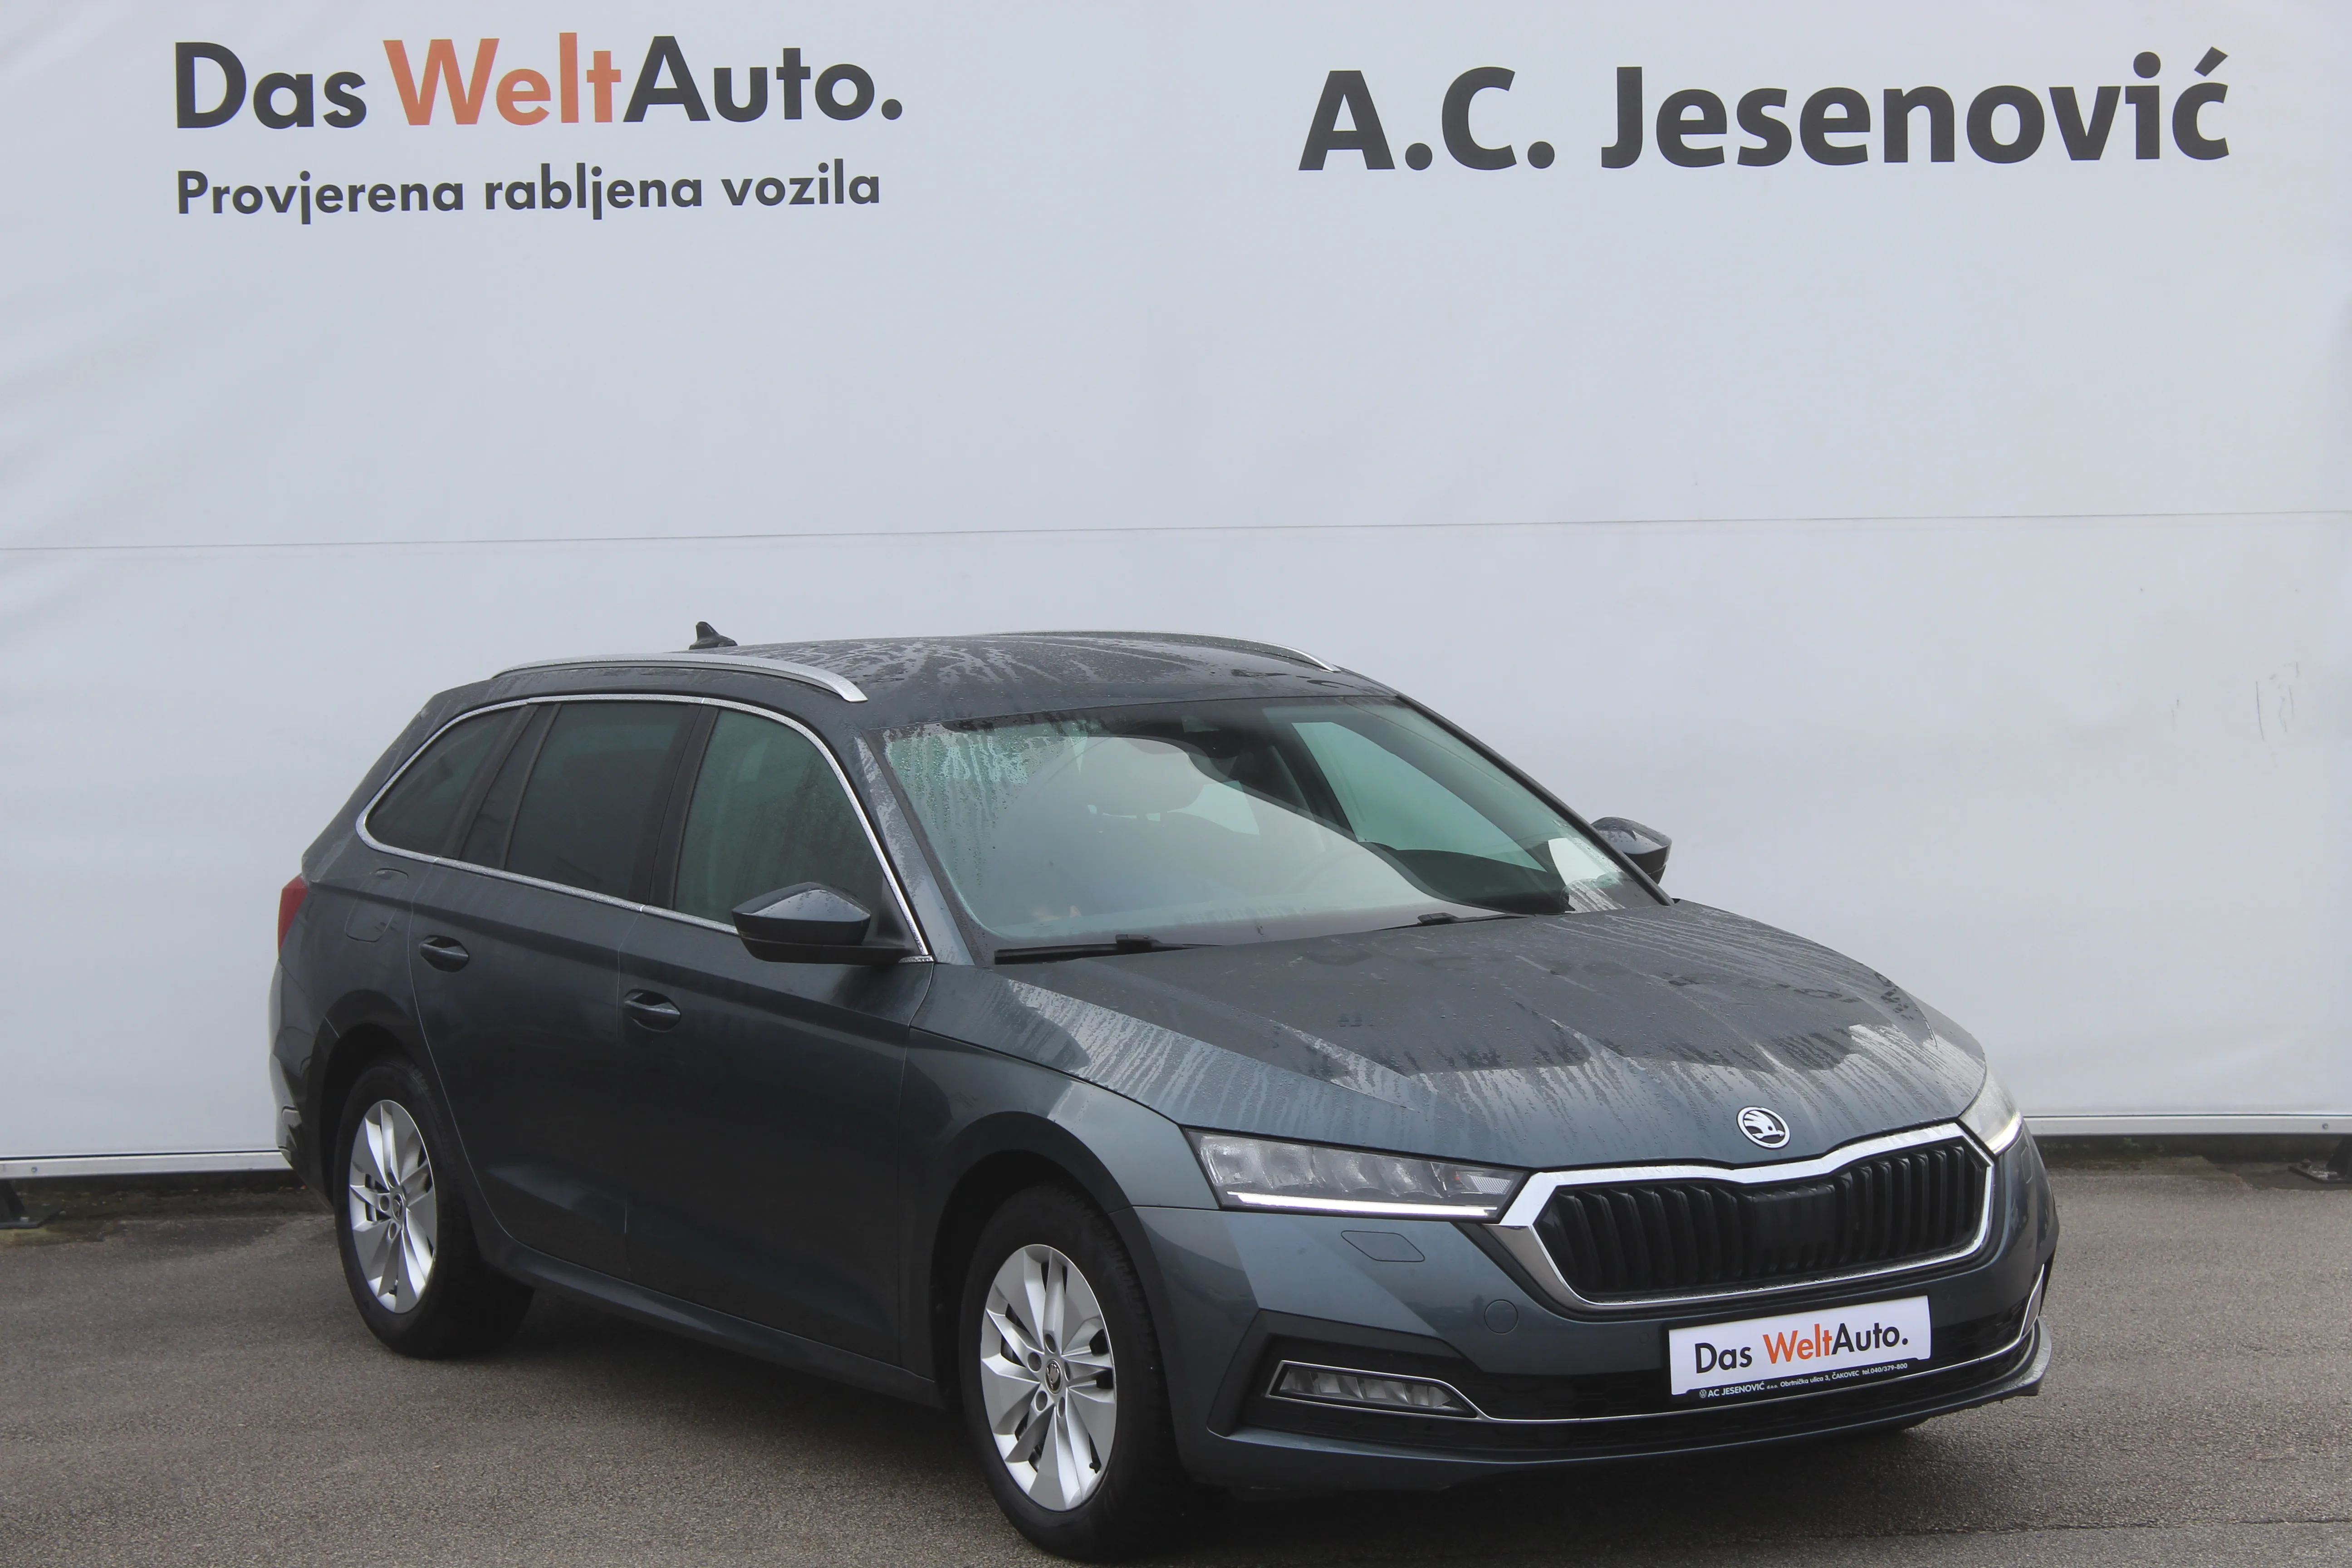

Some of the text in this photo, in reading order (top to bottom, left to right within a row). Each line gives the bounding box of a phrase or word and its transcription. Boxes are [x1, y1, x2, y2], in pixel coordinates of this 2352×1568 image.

[176, 33, 902, 129] Das WeltAuto.
[1298, 47, 2229, 171] A.C. Jesenović
[178, 159, 879, 225] Provjerena rabljena vozila
[1695, 1323, 1908, 1373] Das WeltAuto.
[1708, 1389, 1720, 1397] AC
[1721, 1381, 1765, 1396] JESENOVIĆ
[1780, 1378, 1809, 1387] Obrtnička
[1832, 1370, 1860, 1380] ČAKOVEC
